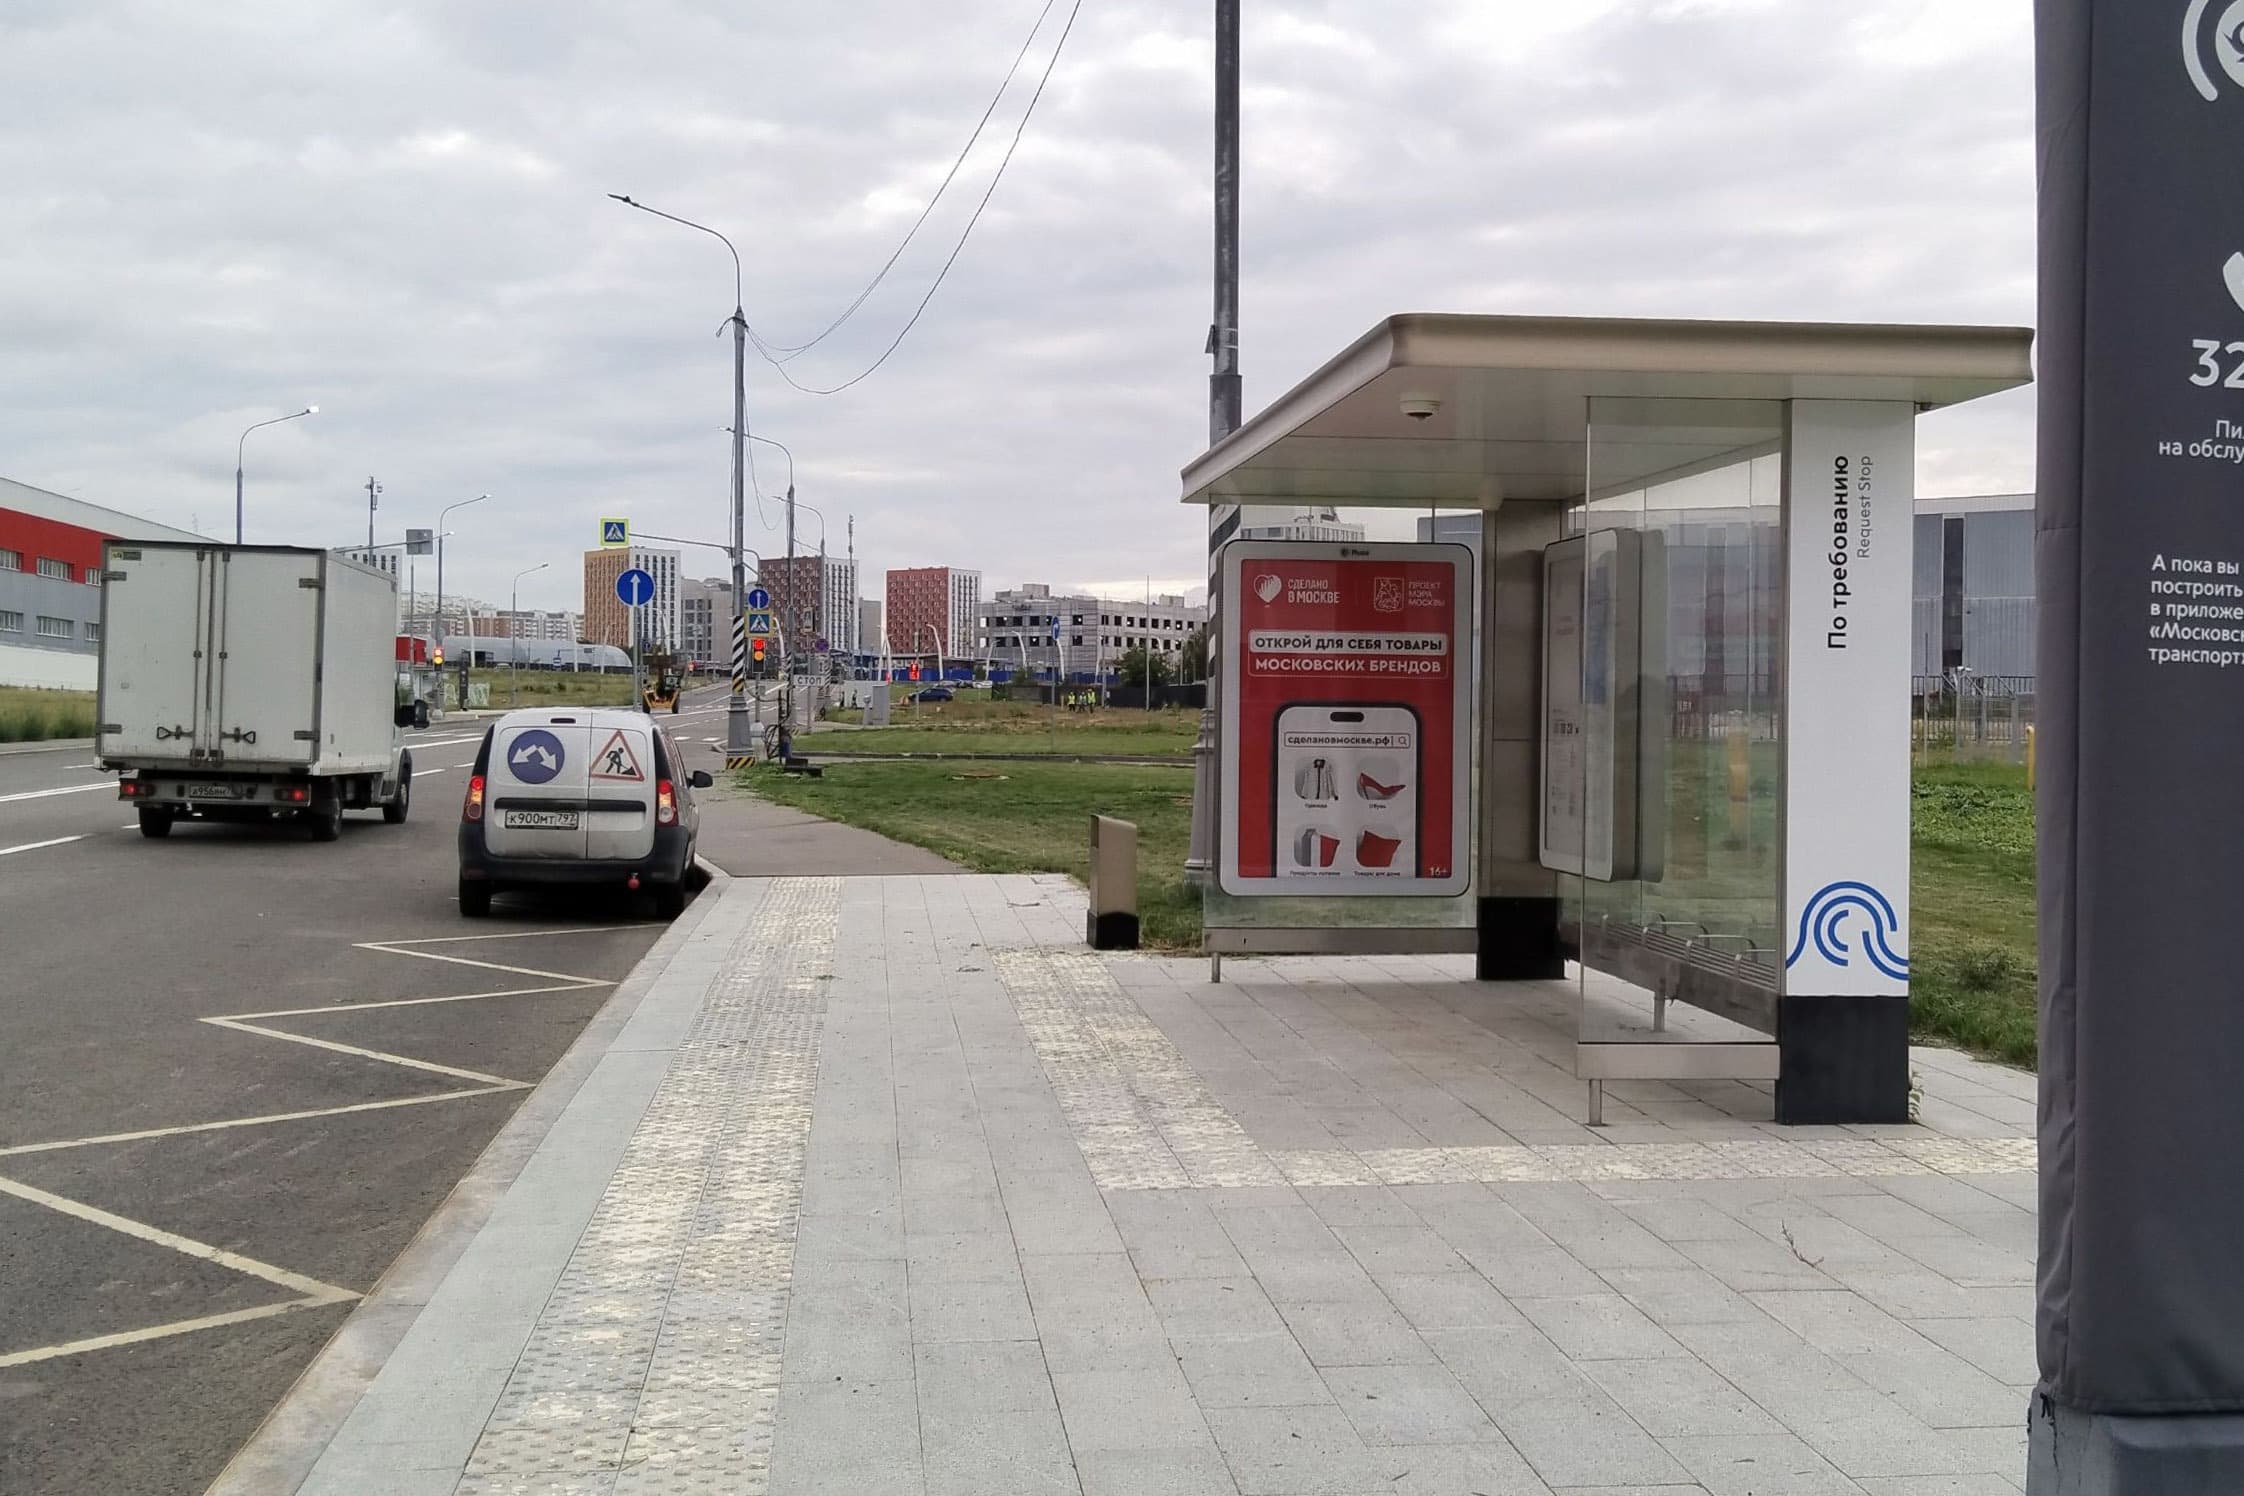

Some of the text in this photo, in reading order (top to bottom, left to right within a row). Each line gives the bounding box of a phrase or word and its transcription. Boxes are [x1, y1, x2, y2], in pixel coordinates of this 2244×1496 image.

[2189, 339, 2244, 388] 32
[2216, 420, 2244, 439] Пи
[2159, 441, 2182, 456] на
[1857, 456, 1873, 558] Request Stop
[1828, 456, 1851, 649] По требованию
[2152, 554, 2239, 575] А пока вы
[1288, 579, 1329, 591] СДЕЛАНО
[2151, 580, 2244, 599] построить
[1288, 592, 1341, 604] В МОСКВЕ
[2151, 603, 2244, 621] в приложе
[1255, 635, 1442, 651] ОТКРОЙ ДЛЯ СЕБЯ ТОВАРЫ
[1255, 658, 1441, 673] МОСКОВСКИХ БРЕНДОВ
[2148, 648, 2244, 668] транспорт
[797, 676, 822, 685] СТОП
[1429, 866, 1448, 876] 16+
